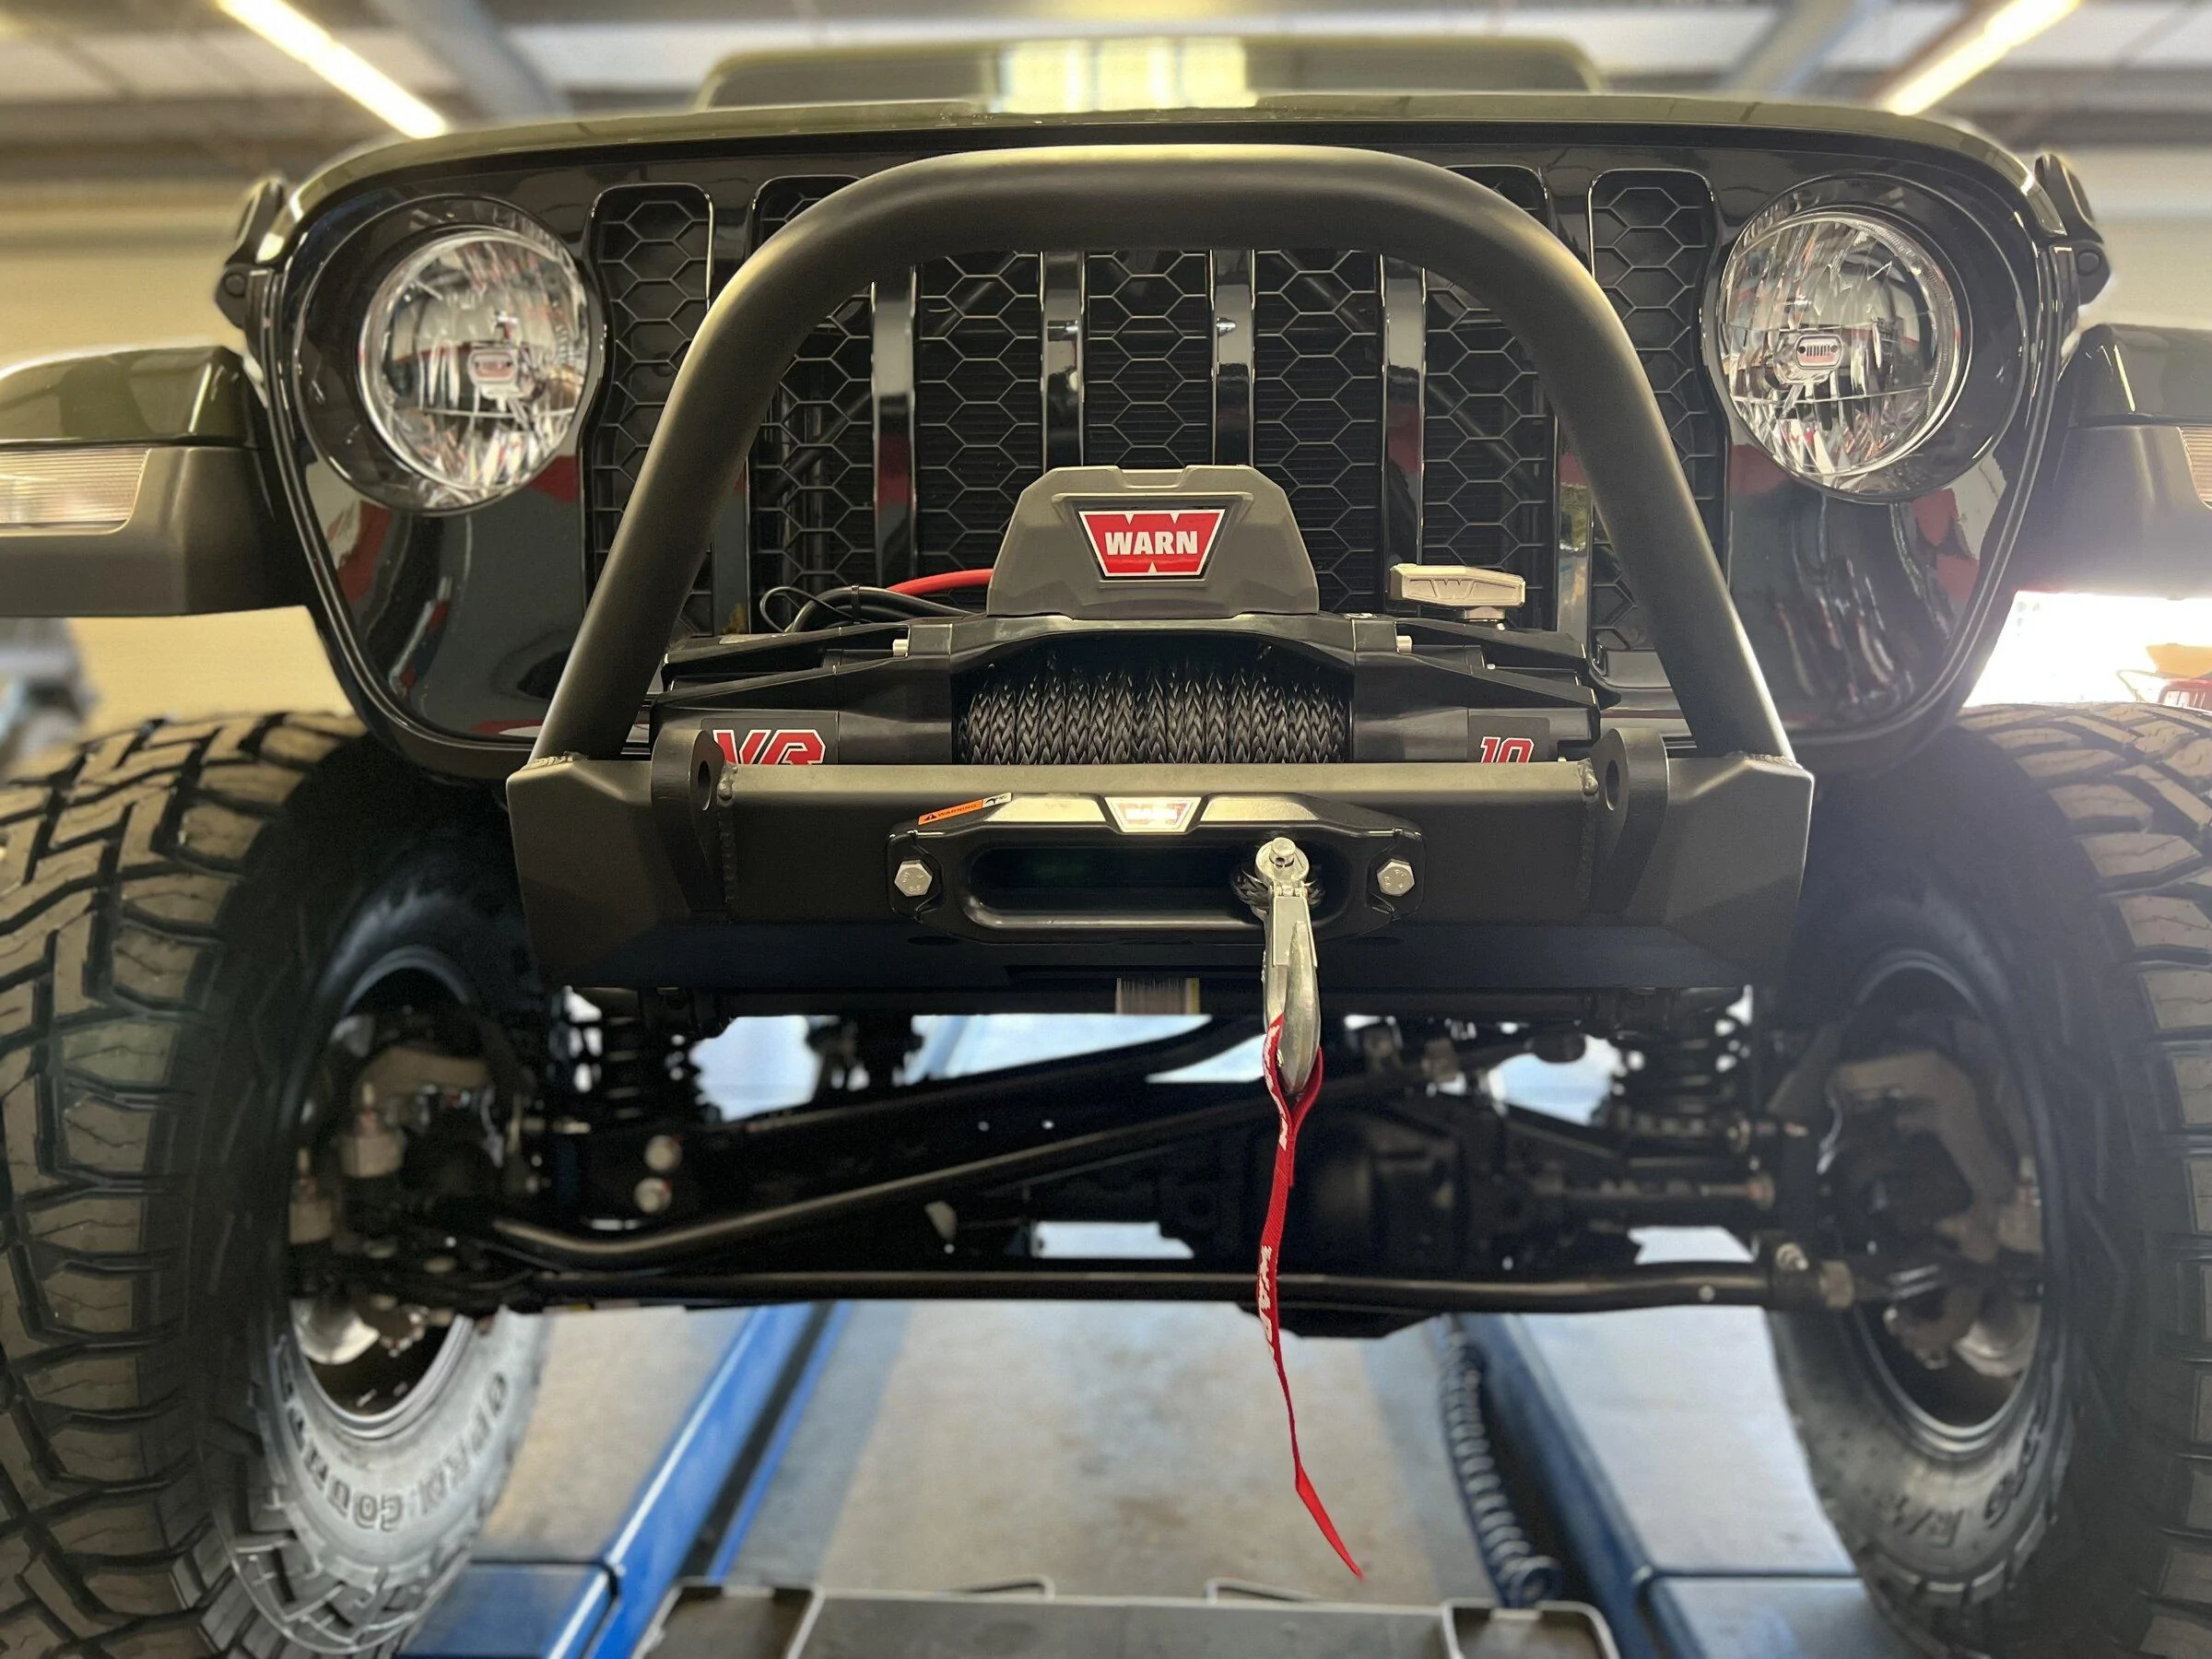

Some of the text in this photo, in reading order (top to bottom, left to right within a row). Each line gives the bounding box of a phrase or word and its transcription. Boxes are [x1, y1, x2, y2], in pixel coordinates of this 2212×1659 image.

[1104, 530, 1198, 556] WARN
[1480, 736, 1535, 763] 10
[937, 803, 977, 817] WARNING
